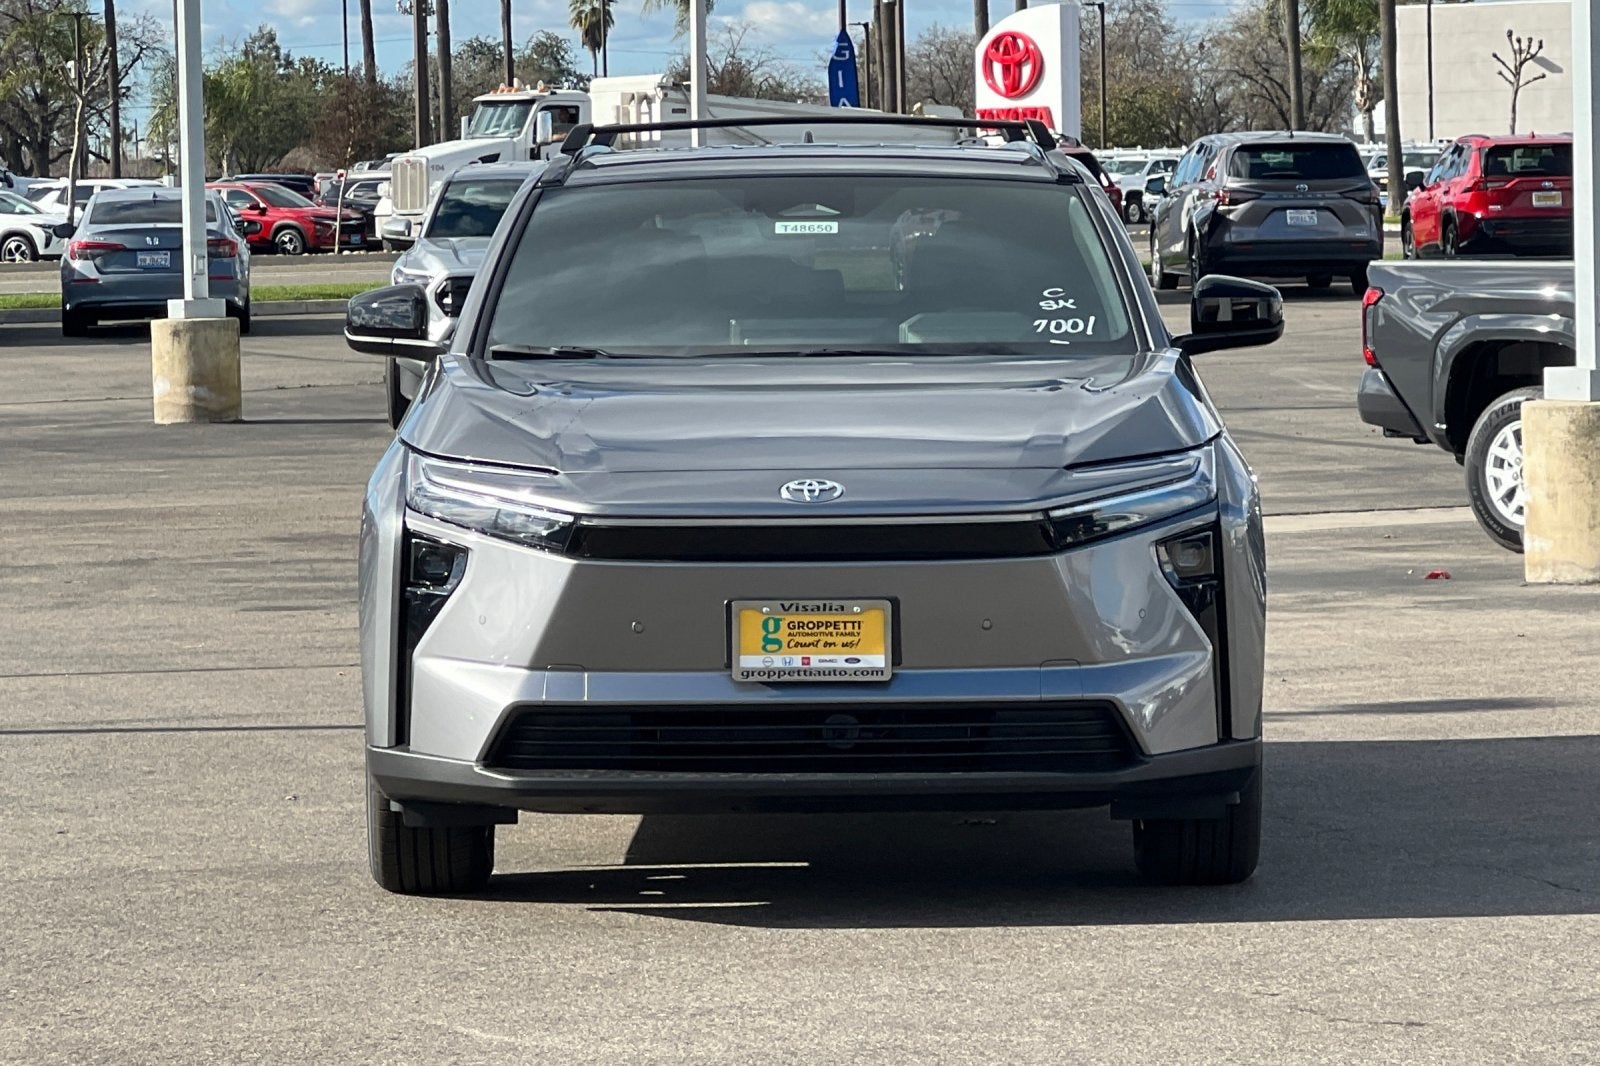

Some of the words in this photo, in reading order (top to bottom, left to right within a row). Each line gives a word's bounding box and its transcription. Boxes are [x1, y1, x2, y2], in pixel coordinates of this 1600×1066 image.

[781, 224, 833, 233] T48650
[1043, 288, 1066, 298] C
[1033, 315, 1096, 336] 7001
[780, 603, 845, 612] Visalia
[787, 621, 862, 631] GROPPETTI
[787, 638, 821, 650] Count
[841, 639, 861, 649] us!
[741, 668, 884, 680] groppettiauto.com
